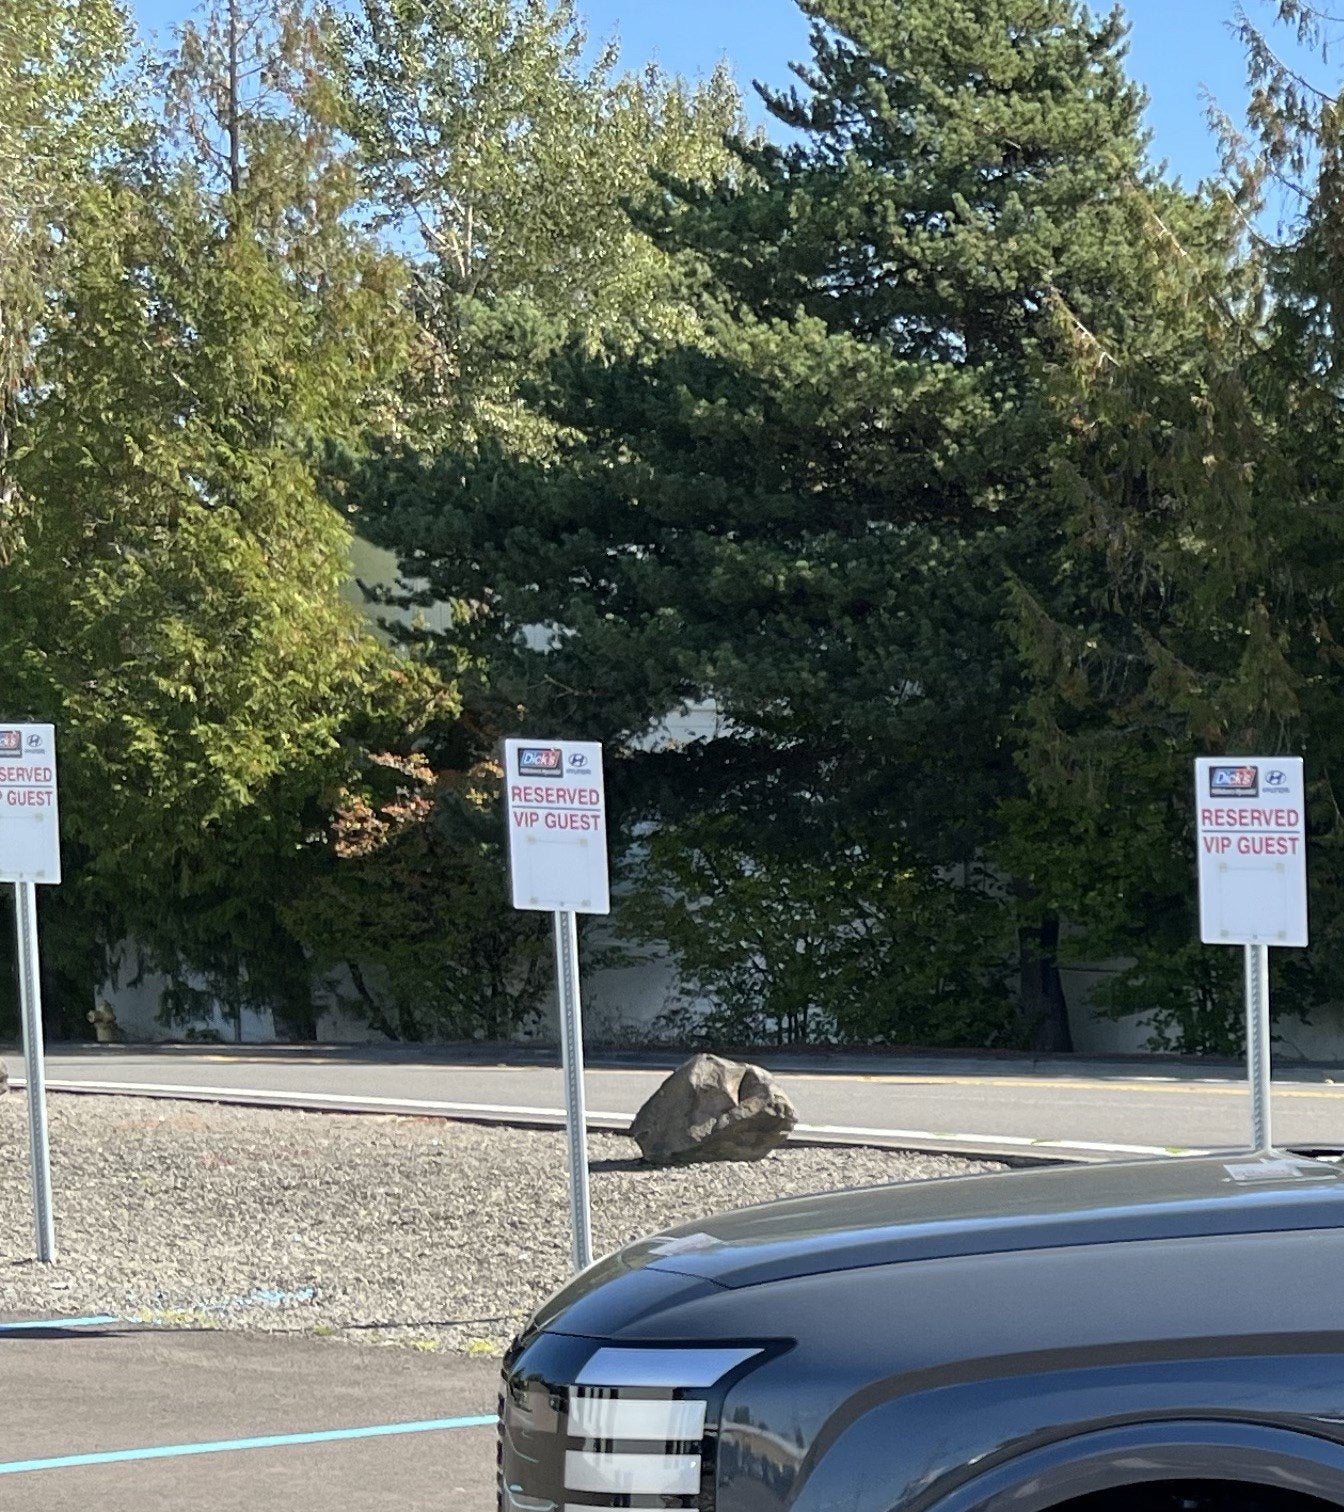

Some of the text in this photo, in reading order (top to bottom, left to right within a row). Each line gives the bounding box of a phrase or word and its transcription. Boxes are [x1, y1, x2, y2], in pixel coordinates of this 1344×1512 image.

[7, 790, 53, 806] GUEST
[511, 785, 600, 806] RESERVED
[512, 811, 601, 831] VIP GUEST
[1201, 808, 1299, 827] RESERVED
[1202, 836, 1300, 855] VIP GUEST
